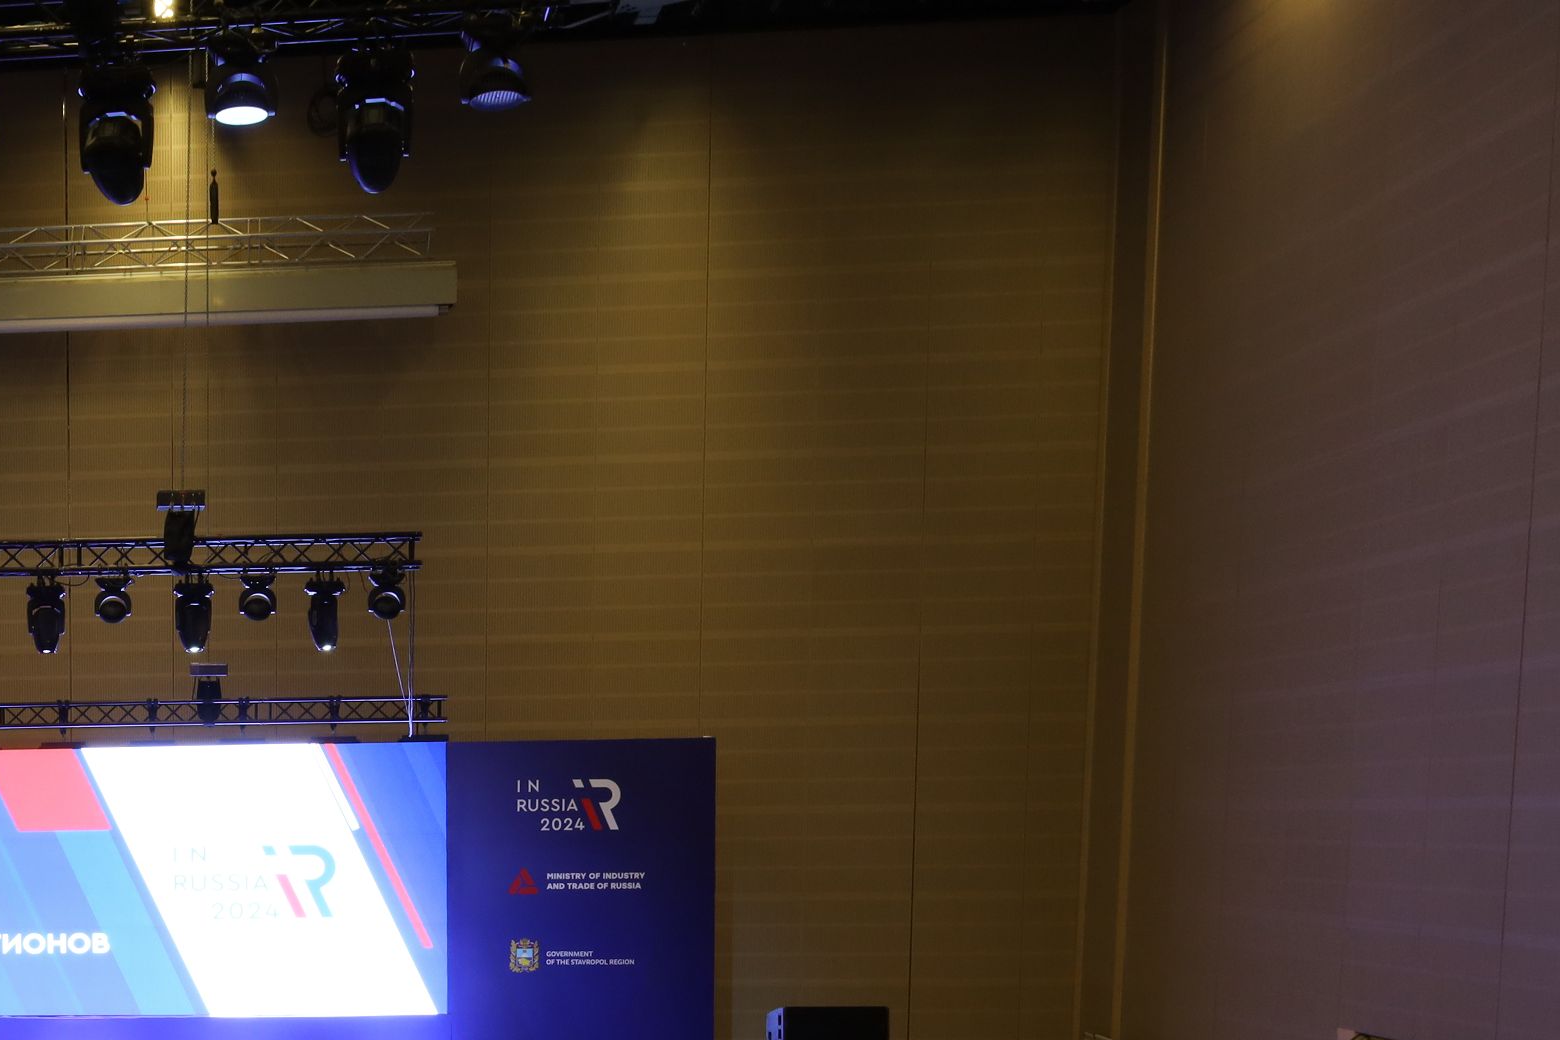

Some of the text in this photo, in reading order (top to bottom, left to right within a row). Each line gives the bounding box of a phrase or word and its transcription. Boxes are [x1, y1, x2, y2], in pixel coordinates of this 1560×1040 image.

[516, 799, 578, 812] RUSSIA
[540, 818, 585, 831] 2024
[174, 874, 268, 891] RUSSIA
[603, 872, 645, 880] INDUSTRY
[213, 902, 279, 920] 2024
